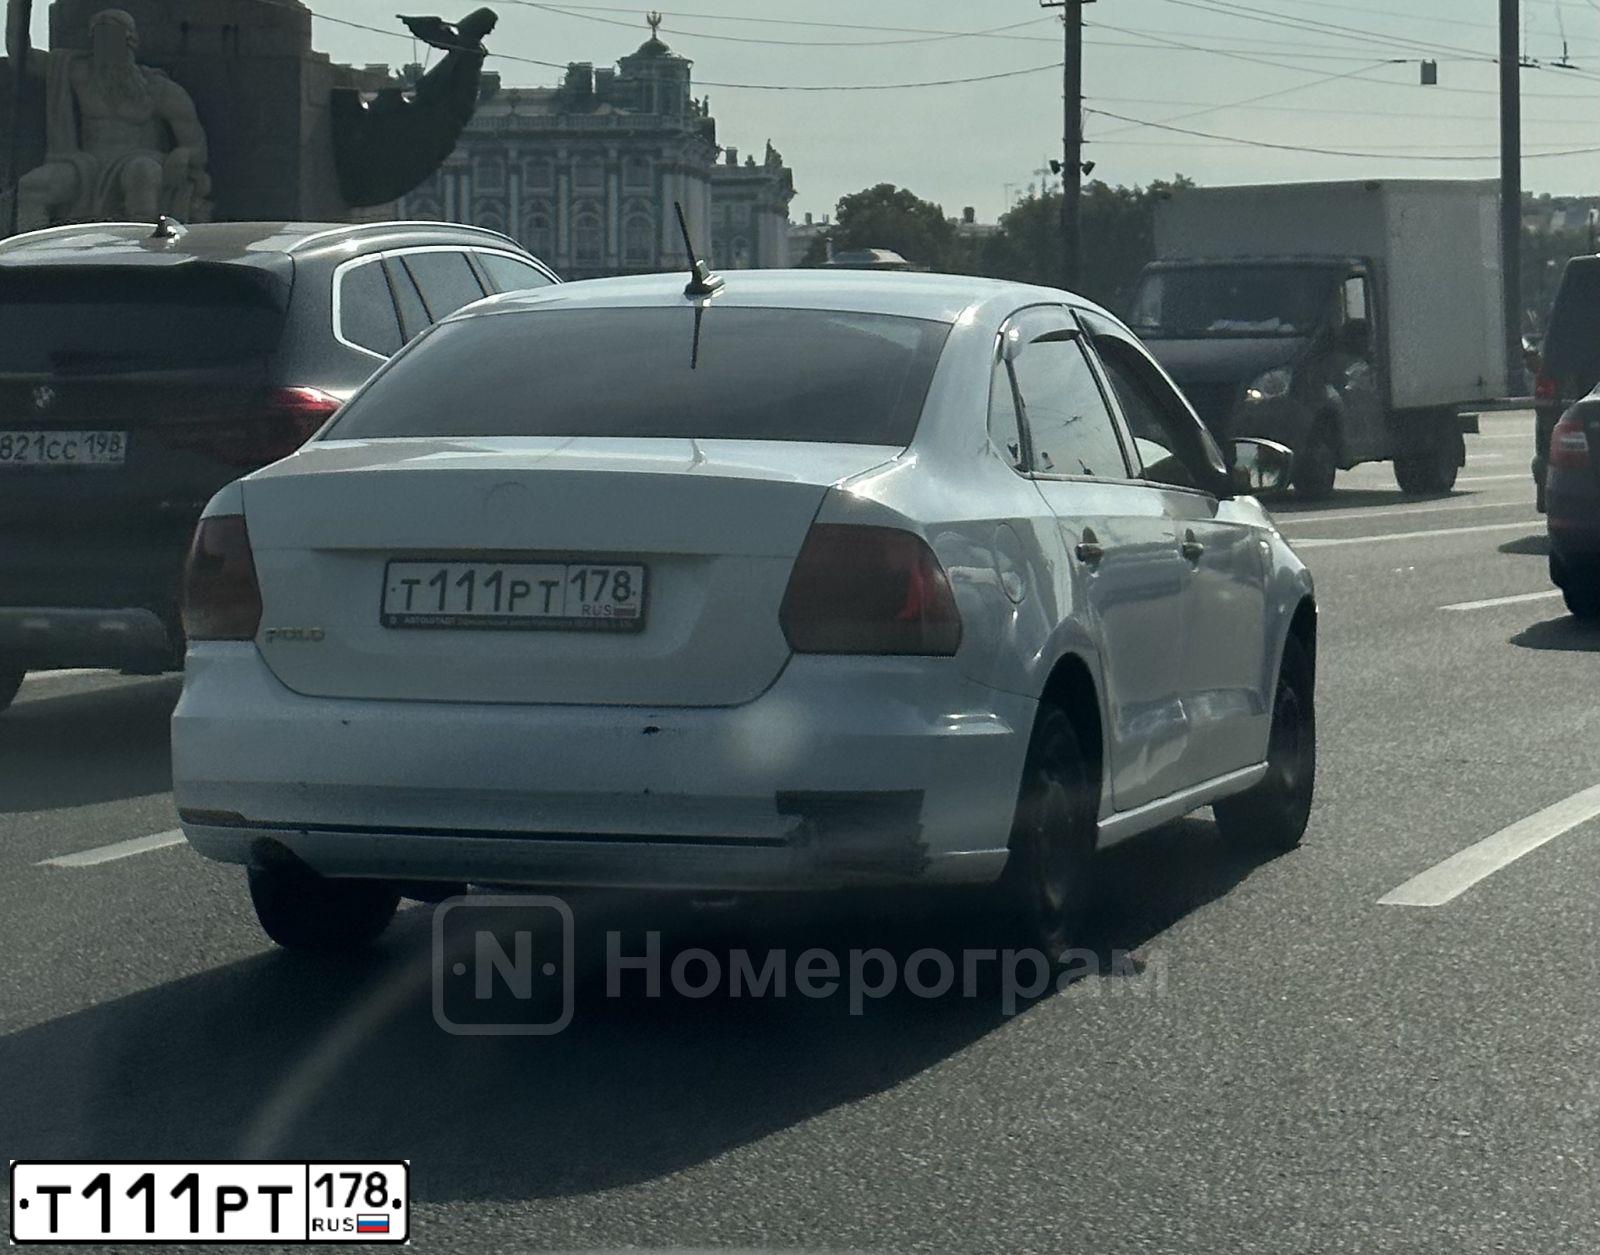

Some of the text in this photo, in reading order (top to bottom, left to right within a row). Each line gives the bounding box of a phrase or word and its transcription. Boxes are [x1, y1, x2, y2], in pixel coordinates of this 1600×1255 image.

[401, 569, 631, 613] Т111РТ 178
[582, 604, 612, 616] RUS
